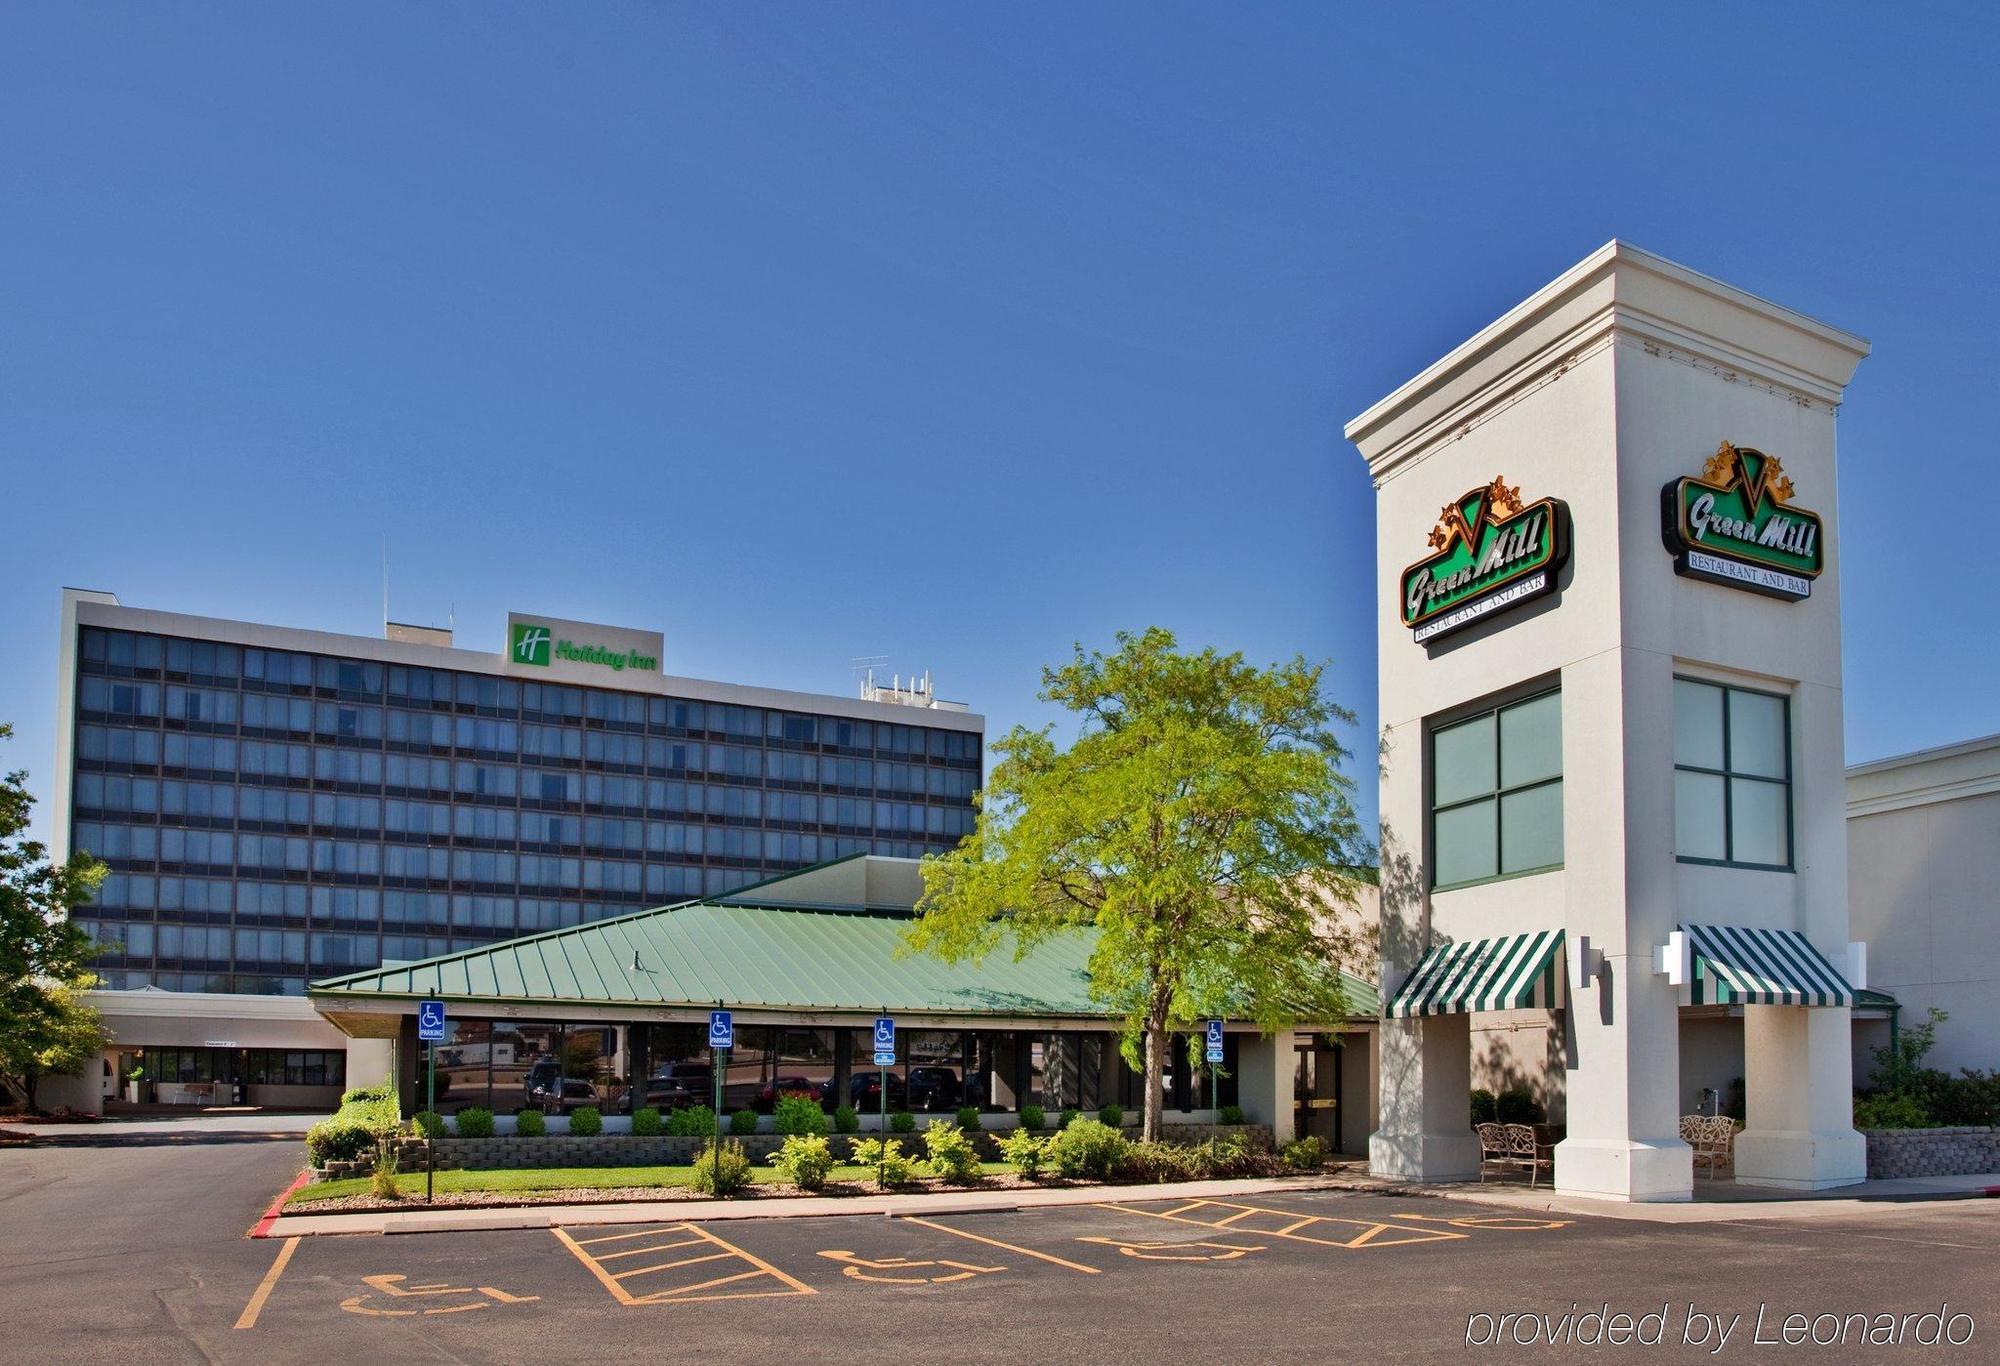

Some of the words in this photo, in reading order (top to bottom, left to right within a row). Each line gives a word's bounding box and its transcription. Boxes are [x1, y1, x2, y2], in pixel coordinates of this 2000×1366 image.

[1690, 493, 1756, 542] Green
[1758, 514, 1816, 557] Mill
[1407, 568, 1472, 620] Green
[1472, 511, 1543, 579] Mill
[1691, 554, 1757, 581] RESTAURANT
[1763, 573, 1784, 588] AND
[1788, 578, 1807, 593] BAR
[1417, 605, 1483, 639] RESTAURANT
[1489, 589, 1515, 608] AND
[1520, 576, 1543, 594] BAR
[555, 639, 626, 671] Holiday
[628, 649, 657, 671] Inn
